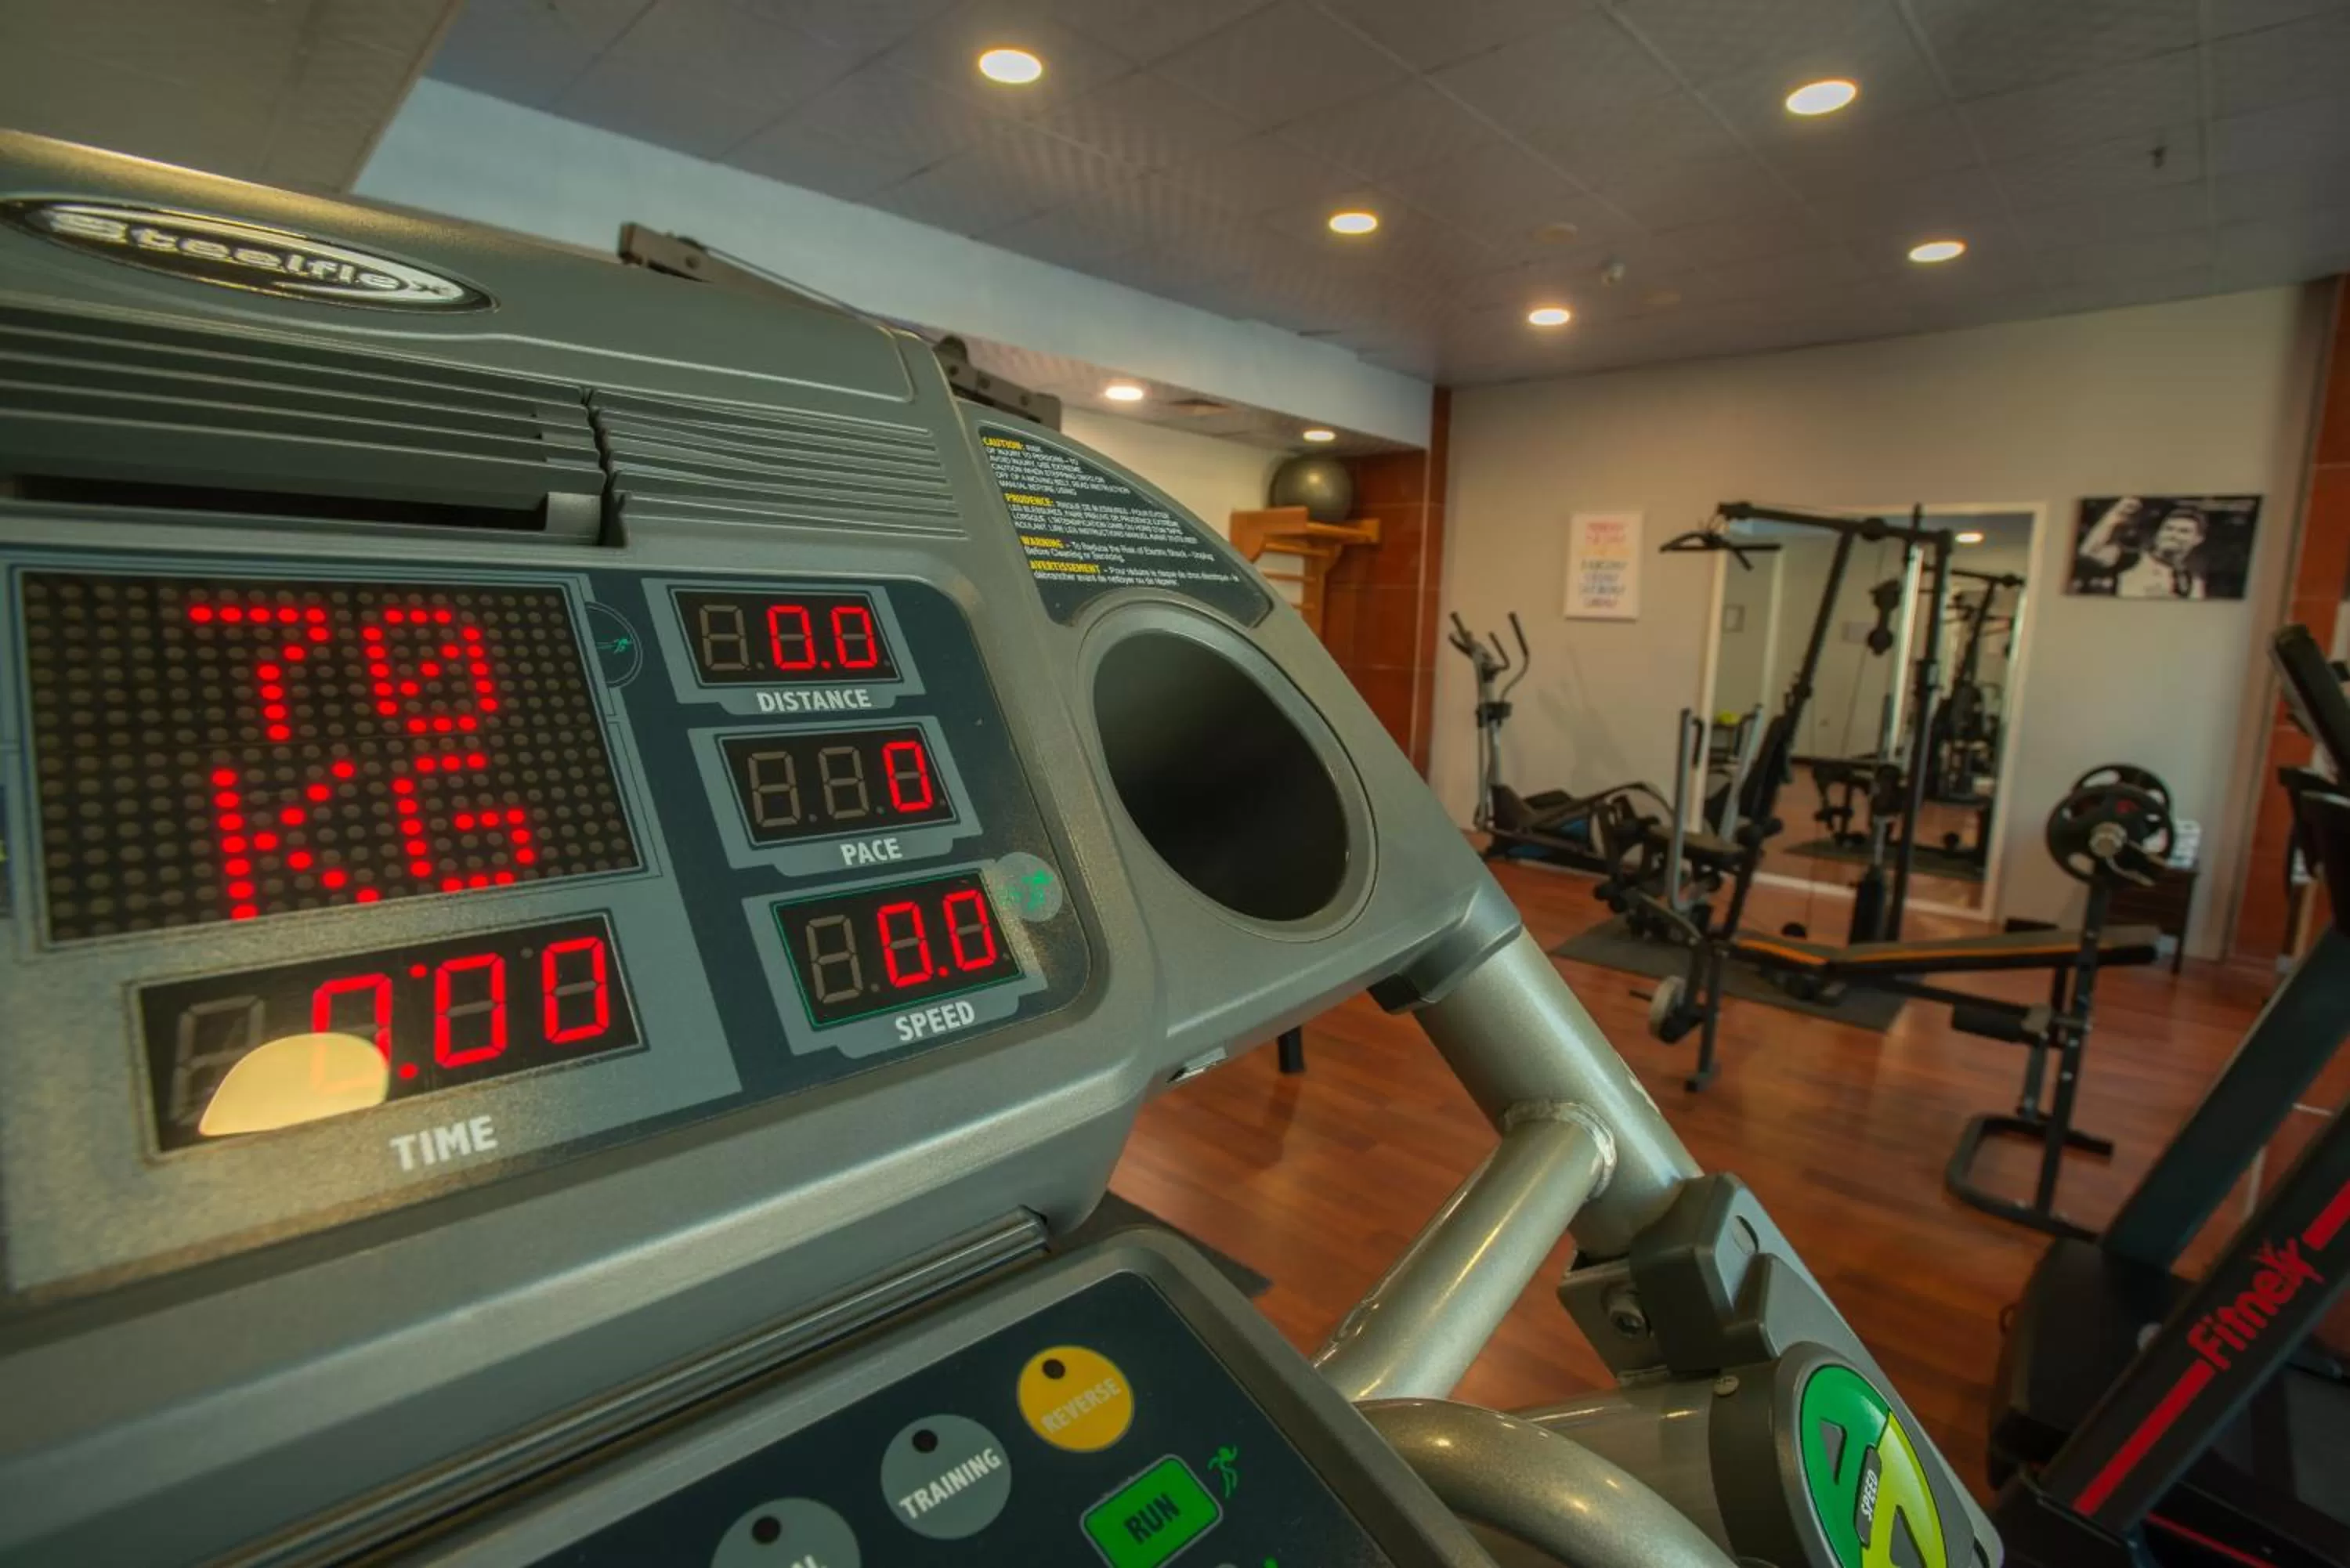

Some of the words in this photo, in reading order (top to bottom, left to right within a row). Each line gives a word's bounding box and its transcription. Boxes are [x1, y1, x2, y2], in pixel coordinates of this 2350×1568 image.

[49, 211, 455, 295] Steelflex
[766, 604, 879, 670] 0.0
[756, 689, 872, 713] DISTANCE
[881, 740, 935, 813] 0
[212, 752, 537, 922] KG
[840, 837, 903, 865] PACE
[877, 888, 998, 988] 0.0
[895, 1001, 976, 1042] SPEED
[389, 1115, 498, 1171] TIME
[1040, 1376, 1123, 1436] REVERSE
[898, 1447, 1003, 1520] TRAINING
[1860, 1469, 1878, 1523] SPEED
[1123, 1492, 1180, 1545] RUN
